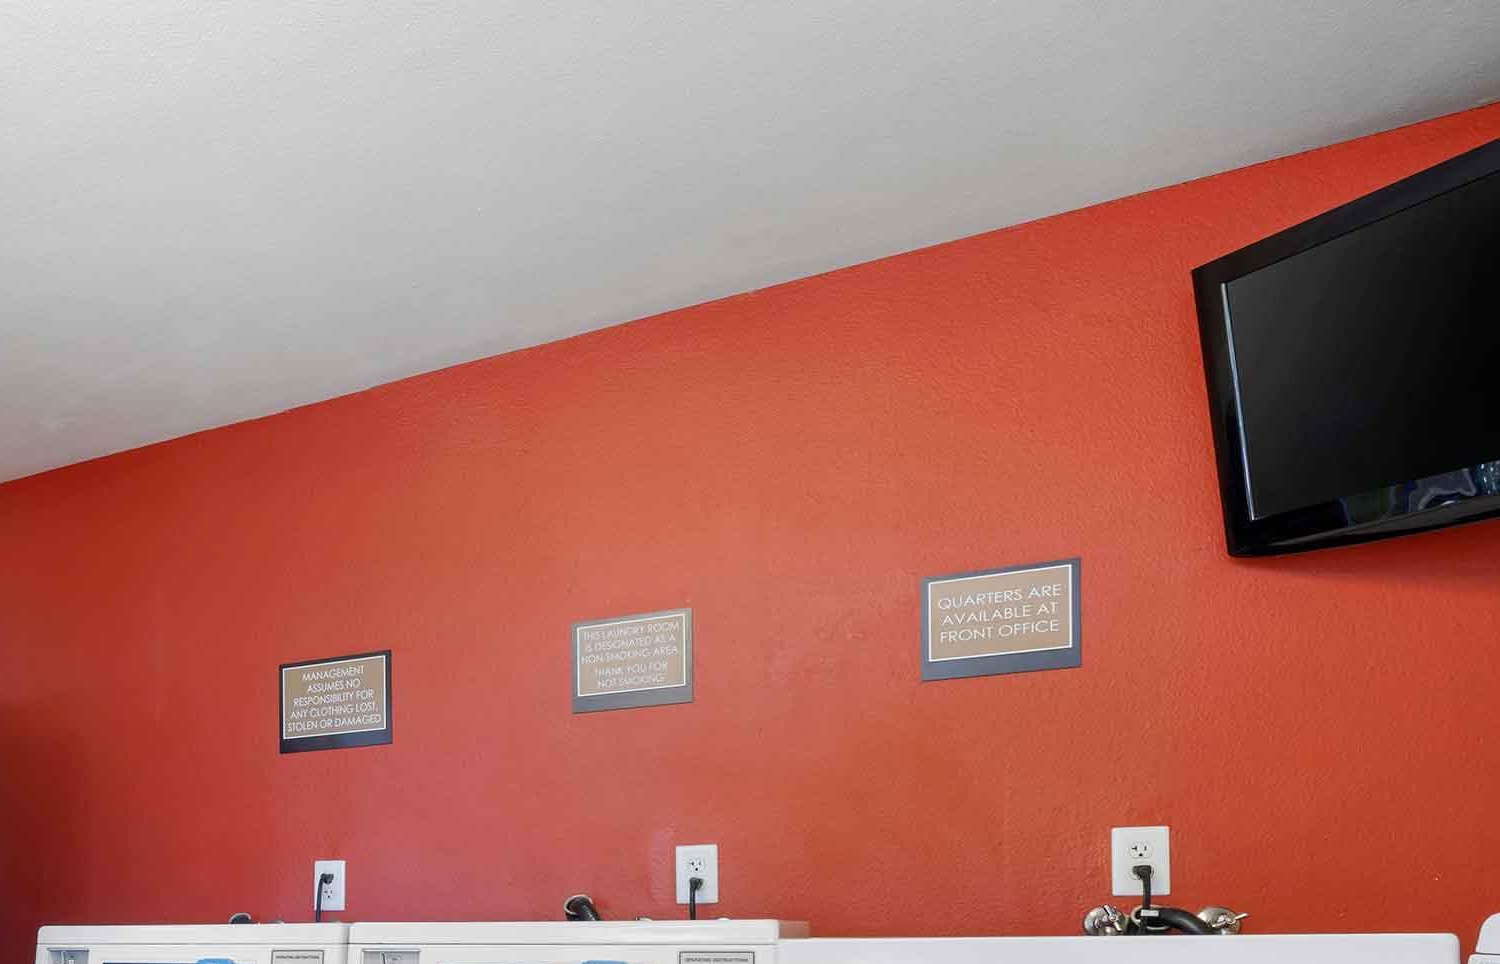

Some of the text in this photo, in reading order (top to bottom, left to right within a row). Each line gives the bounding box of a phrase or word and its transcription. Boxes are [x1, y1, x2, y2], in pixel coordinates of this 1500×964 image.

[938, 583, 1061, 611] QUARTERS ARE
[941, 602, 1058, 626] AVAILABLE AT
[940, 618, 1060, 644] FRONT OFFICE
[302, 665, 364, 682] MANAGEMENT
[307, 678, 360, 693] ASSUMES NO
[293, 689, 374, 707] RESPONSIBILITY FOR
[291, 709, 308, 719] ANY
[310, 704, 353, 717] CLOTHING
[288, 713, 381, 732] STOLEN OR DAMAGED
